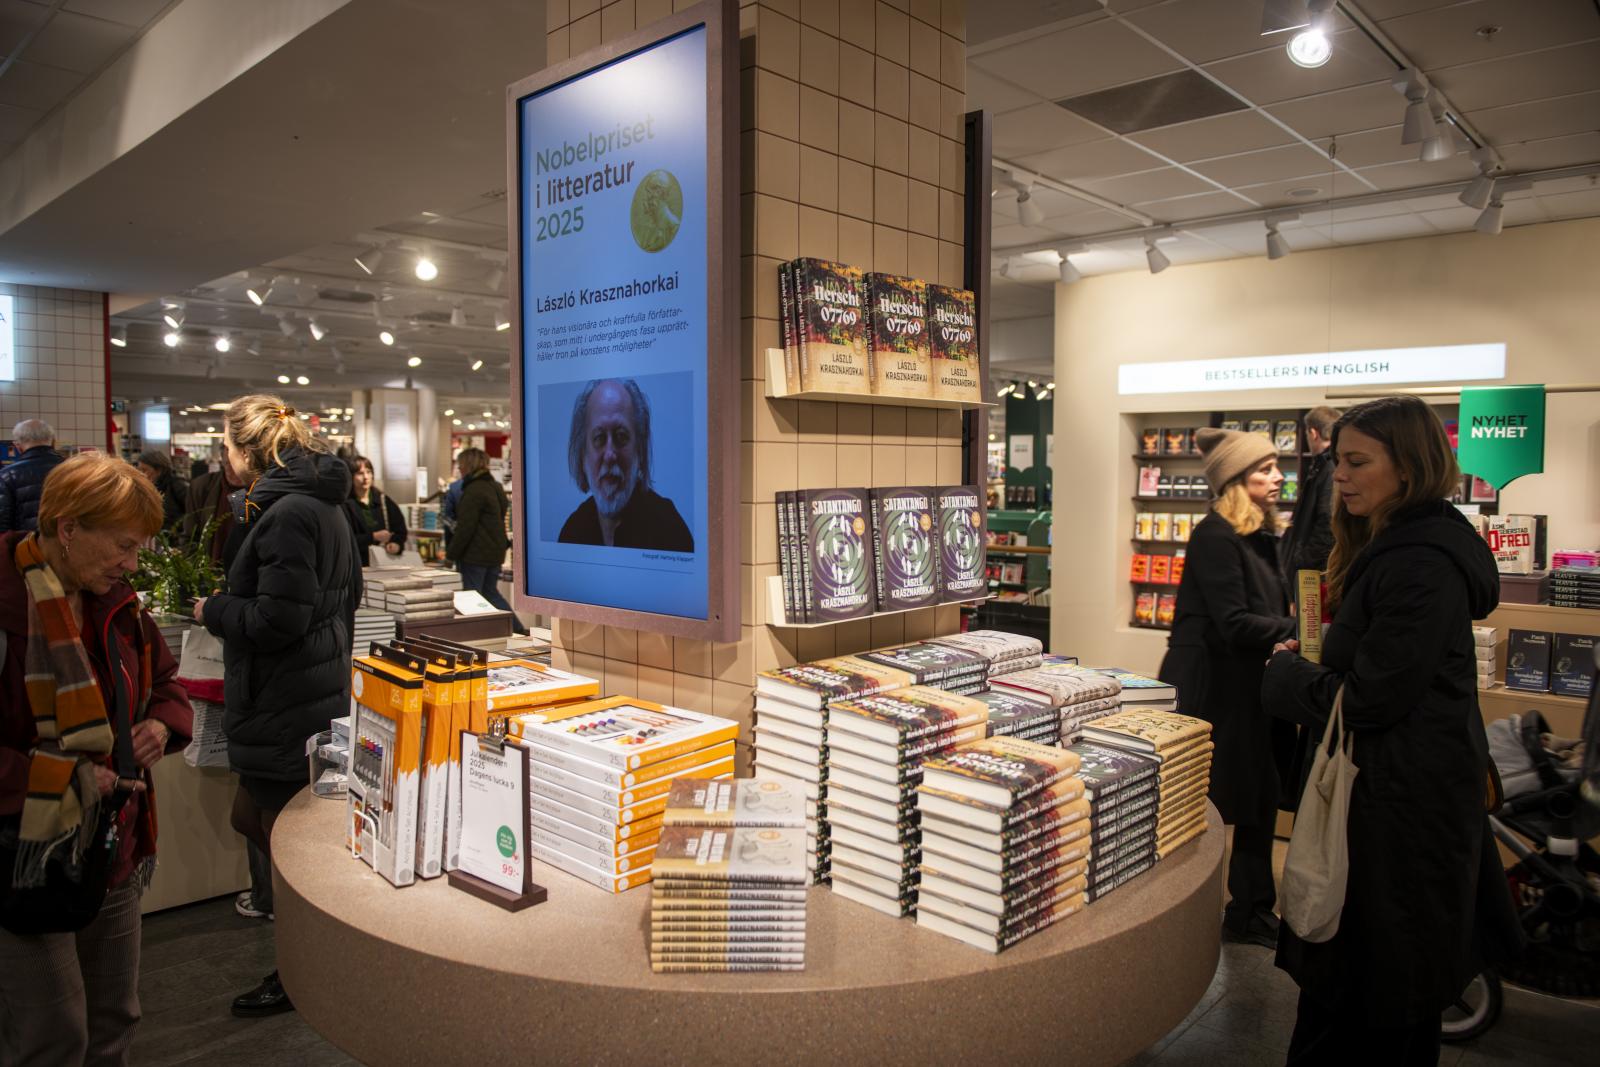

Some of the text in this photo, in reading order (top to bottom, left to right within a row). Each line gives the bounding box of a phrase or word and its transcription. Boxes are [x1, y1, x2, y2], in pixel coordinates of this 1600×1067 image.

[536, 113, 656, 175] Nobelpriset
[536, 160, 635, 209] i litteratur
[536, 206, 584, 242] 2025
[537, 271, 679, 313] László Krasznahorkai
[814, 285, 860, 307] Herscht
[821, 307, 856, 326] 07769
[880, 298, 923, 318] Herscht
[551, 324, 566, 334] hans
[568, 321, 597, 333] visionära
[598, 318, 612, 328] och
[613, 312, 646, 326] kraftfulla
[936, 308, 974, 326] Herscht
[886, 318, 920, 335] 07769
[942, 327, 971, 342] 07769
[554, 338, 568, 347] som
[570, 334, 584, 345] mitt
[588, 327, 638, 343] undergångens
[555, 350, 568, 360] tron
[570, 348, 579, 358] på
[580, 345, 610, 357] konstens
[820, 364, 864, 377] KRASZNAHORKAI
[886, 372, 928, 383] KRASZNAHORKAI
[1205, 362, 1390, 381] BESTSELLERS IN ENGLISH
[1472, 415, 1528, 426] NYHET
[1471, 426, 1528, 438] NYHET
[812, 499, 862, 516] SATANTANGO
[884, 497, 928, 512] SATANTANGO
[940, 496, 978, 508] SATANTANGO
[892, 586, 934, 598] KRASZNAHORKAI
[948, 580, 984, 590] KRASZNAHORKAI
[821, 596, 868, 608] KRASZNAHORKAI
[470, 758, 485, 770] 2025
[470, 768, 492, 782] Dagens
[494, 776, 509, 788] lucka
